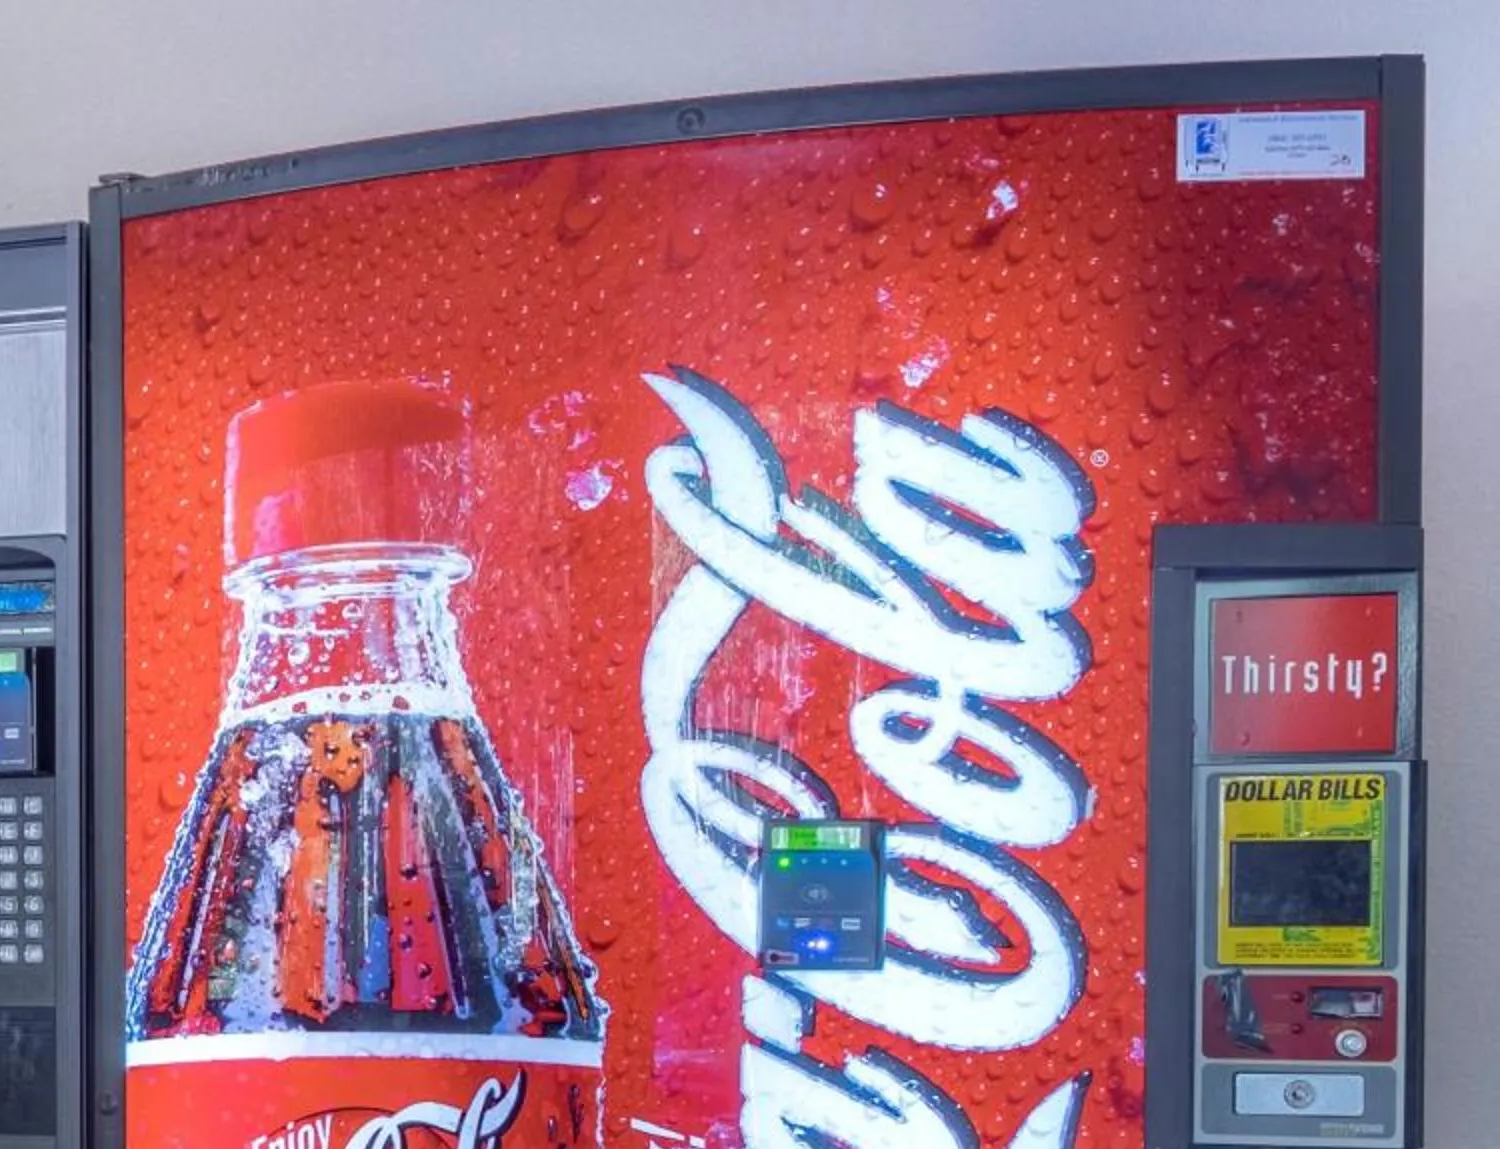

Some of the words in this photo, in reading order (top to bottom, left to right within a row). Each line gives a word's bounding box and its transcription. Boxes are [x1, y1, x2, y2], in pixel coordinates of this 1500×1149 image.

[1221, 651, 1388, 700] Thirsty?
[1224, 780, 1313, 802] DOLLAR
[1317, 777, 1381, 801] BILLS
